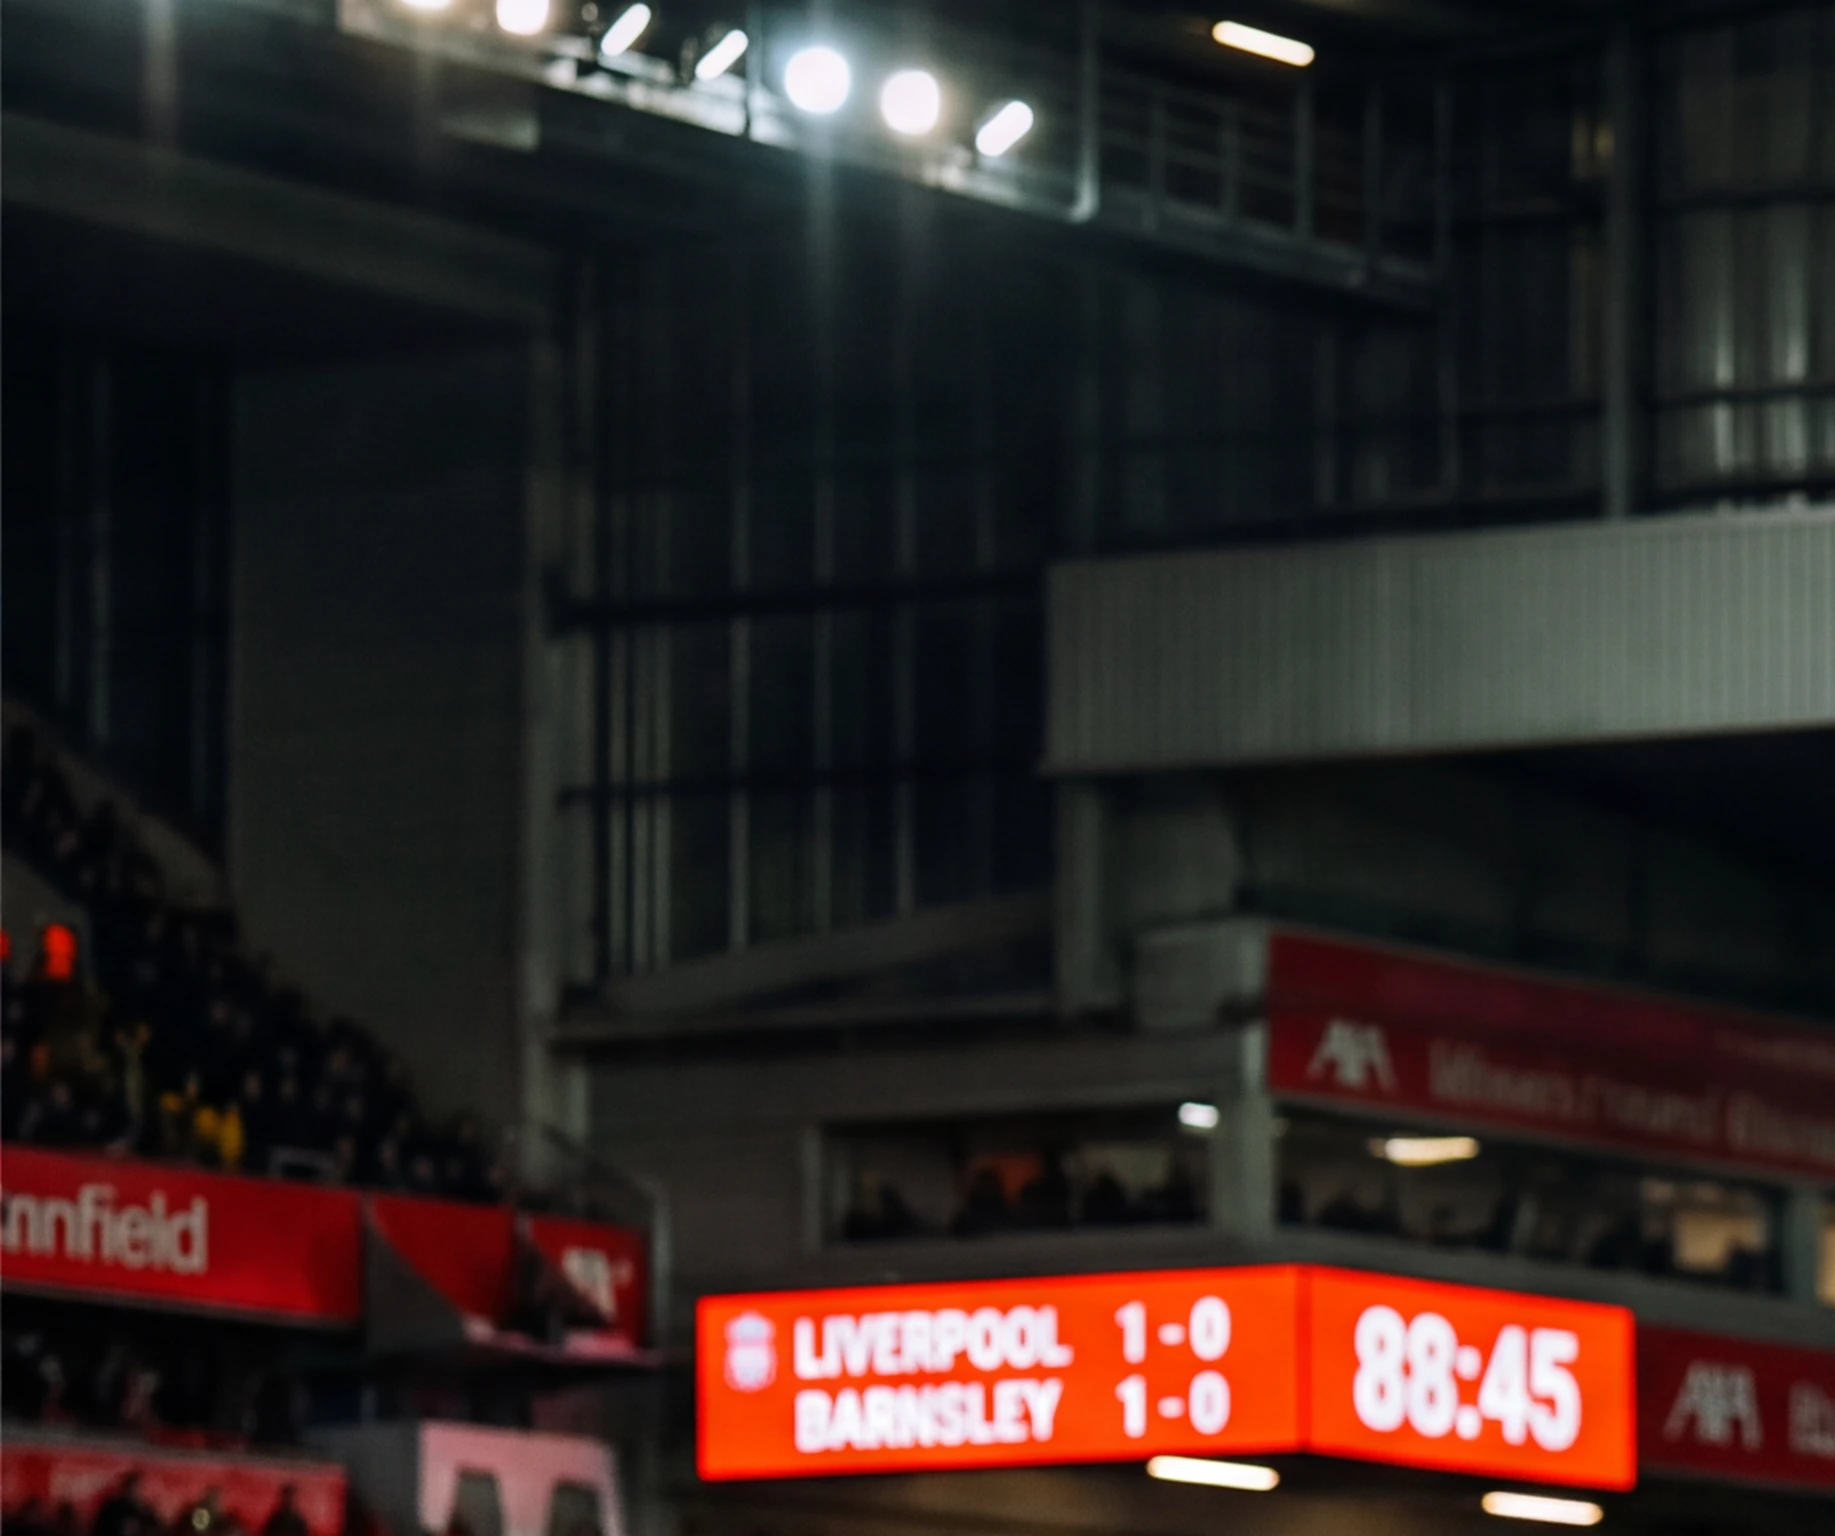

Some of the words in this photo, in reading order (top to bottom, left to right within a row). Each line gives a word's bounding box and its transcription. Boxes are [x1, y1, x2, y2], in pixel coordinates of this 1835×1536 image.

[794, 1304, 1074, 1380] LIVERPOOL
[1353, 1304, 1582, 1452] 88:45
[794, 1377, 1065, 1453] BARNSLEY
